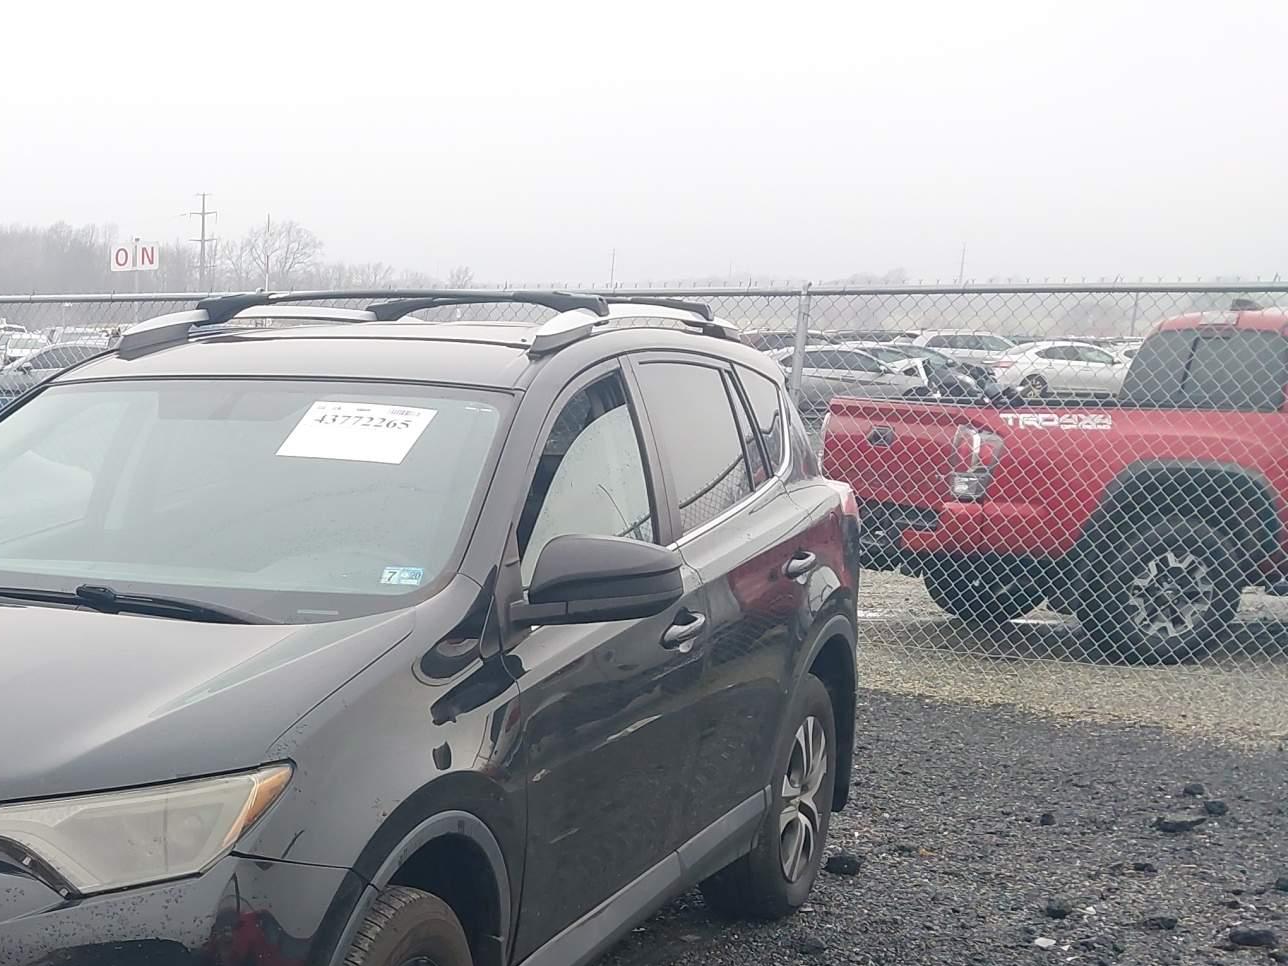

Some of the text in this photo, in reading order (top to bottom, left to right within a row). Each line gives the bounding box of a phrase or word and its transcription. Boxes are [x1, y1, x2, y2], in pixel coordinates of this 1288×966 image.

[141, 246, 155, 266] N
[313, 414, 413, 431] 43772265
[999, 413, 1059, 430] TRD
[387, 570, 398, 582] 7
